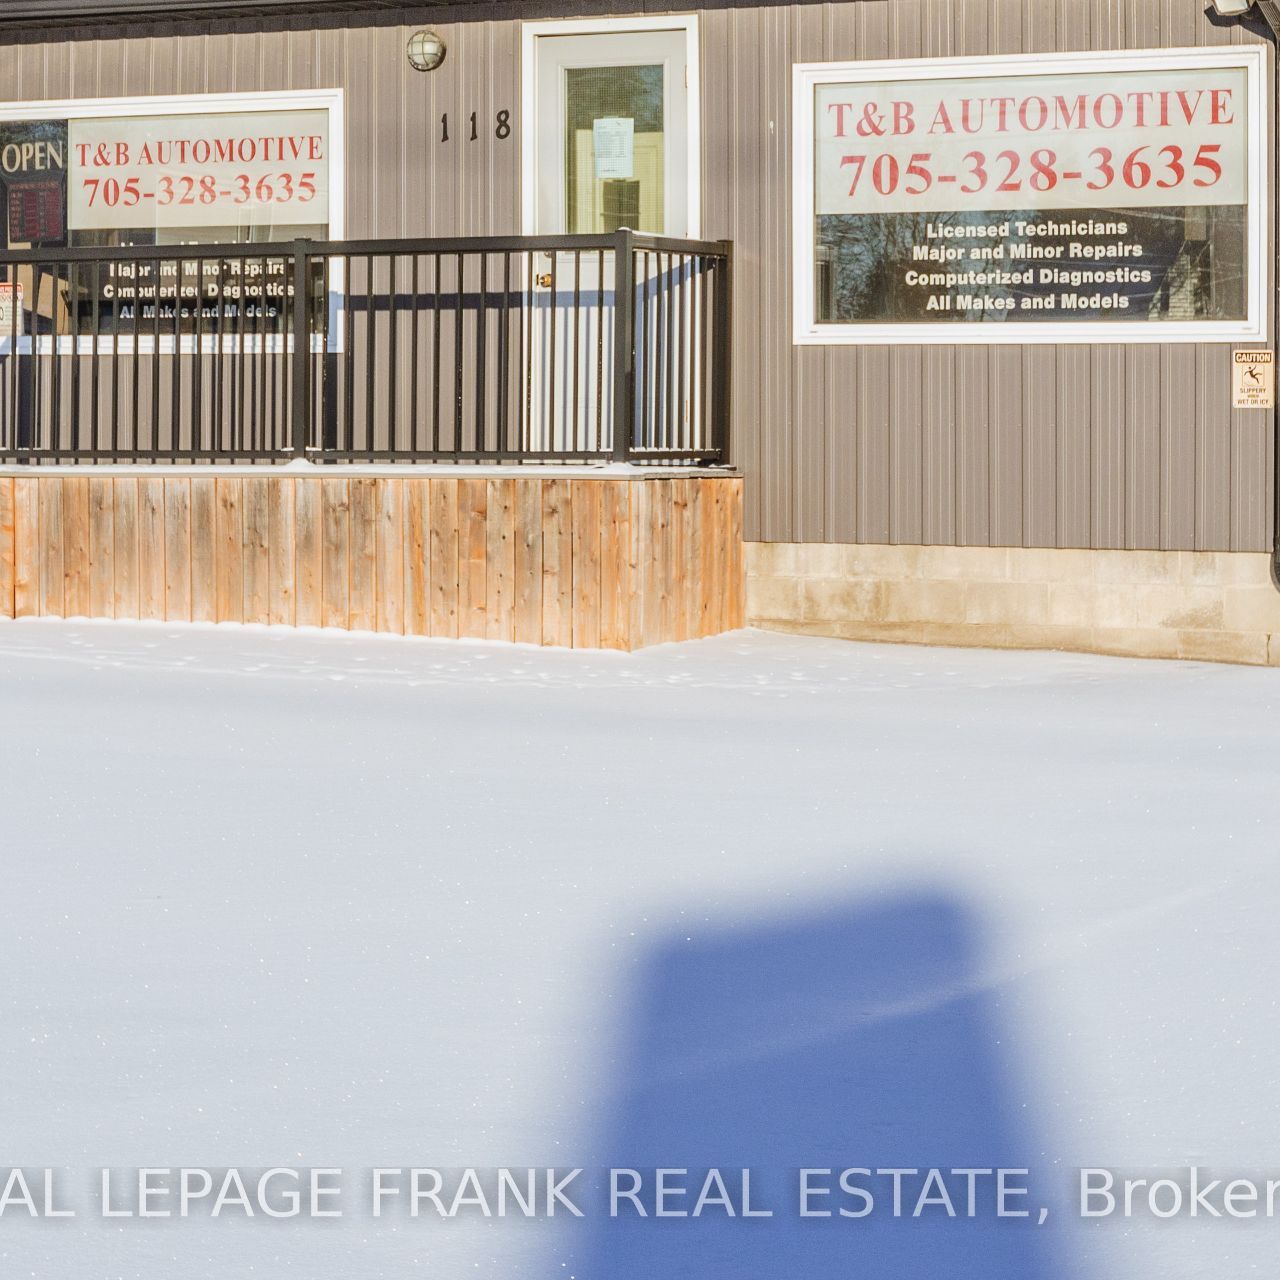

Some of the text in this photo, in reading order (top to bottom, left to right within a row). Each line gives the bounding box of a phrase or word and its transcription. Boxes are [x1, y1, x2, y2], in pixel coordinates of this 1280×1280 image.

[827, 89, 1235, 138] T&B AUTOMOTIVE
[441, 109, 511, 143] 118
[1, 142, 63, 173] OPEN
[75, 135, 324, 167] T&B AUTOMOTIVE
[839, 144, 1222, 198] 705-328-3635
[82, 172, 317, 208] 705-328-3635
[927, 220, 1128, 238] Licensed Technicians
[912, 241, 1143, 262] Major and Minor Repairs
[905, 267, 1152, 288] Computerized Diagnostics
[207, 282, 295, 299] Dagnotics
[224, 303, 278, 318] Mdels
[926, 292, 1130, 311] All Makes and Models
[1236, 353, 1271, 362] CAUTION
